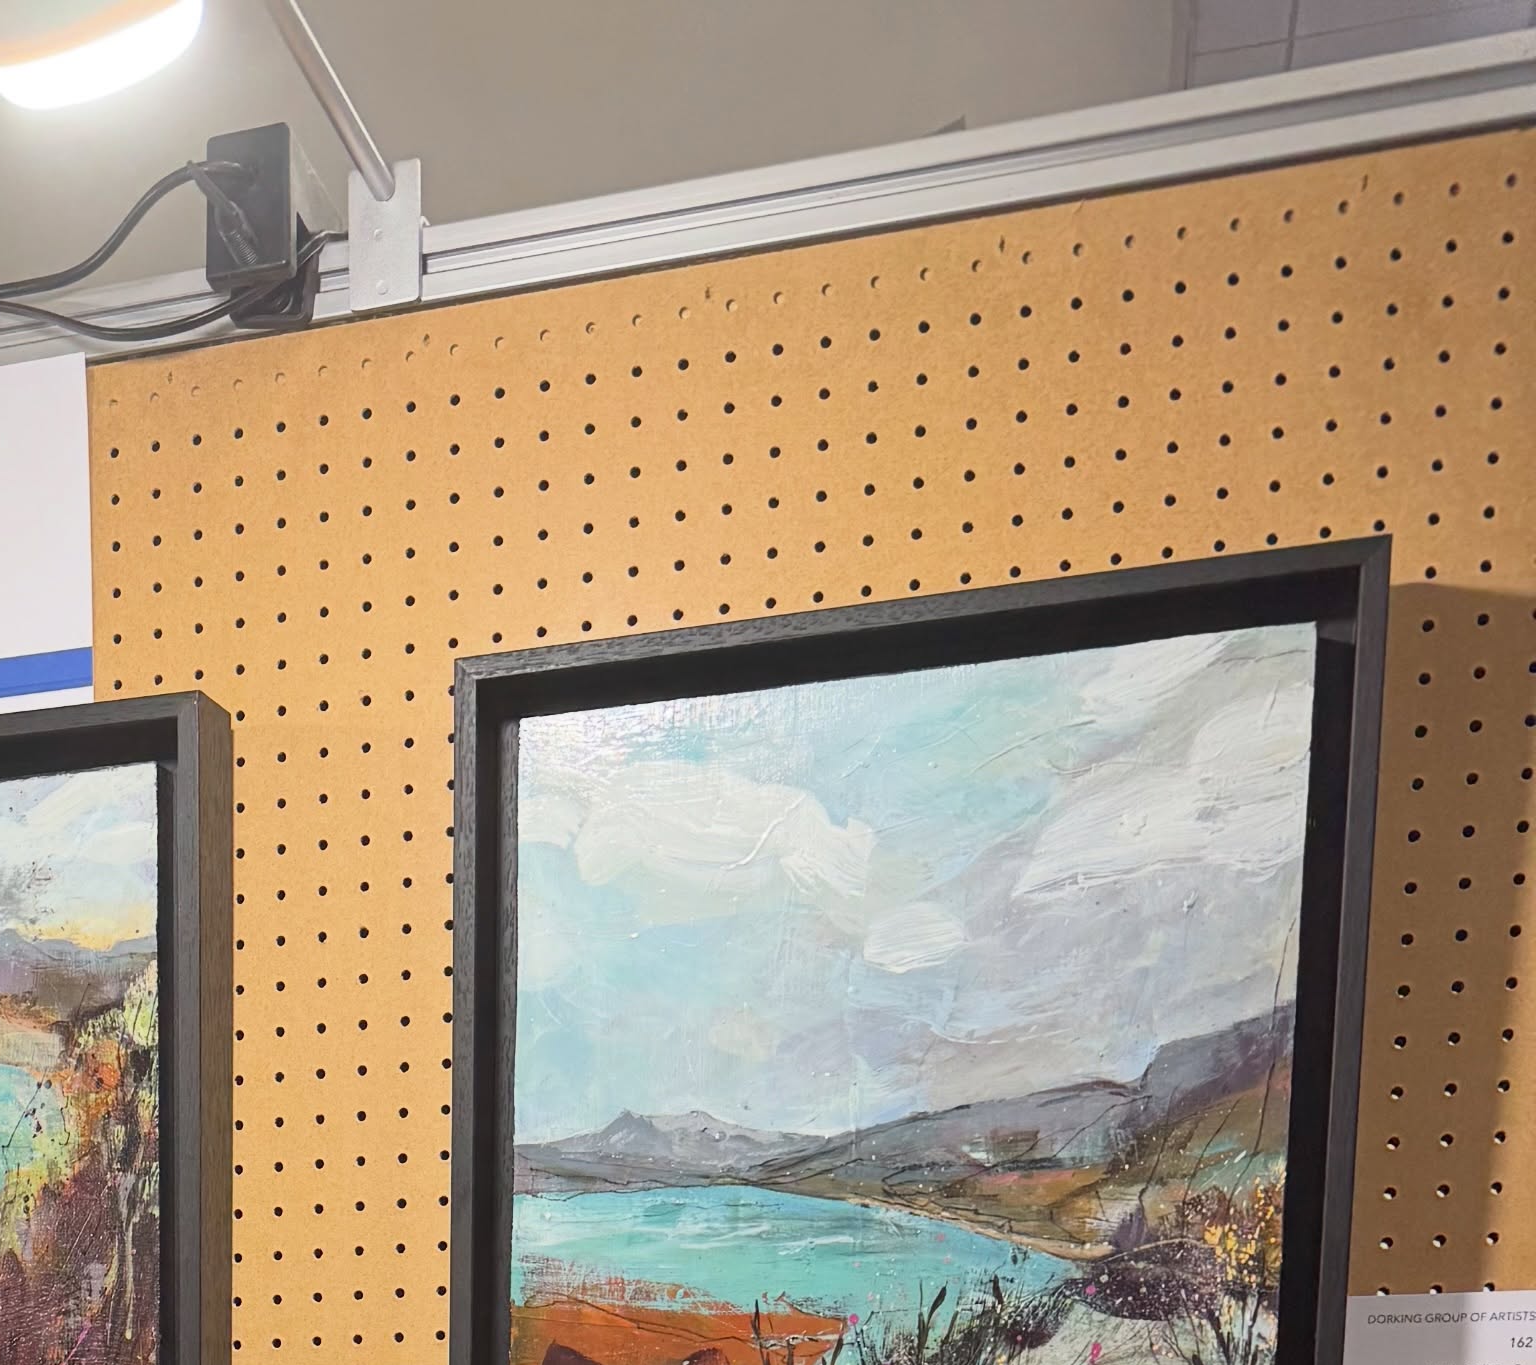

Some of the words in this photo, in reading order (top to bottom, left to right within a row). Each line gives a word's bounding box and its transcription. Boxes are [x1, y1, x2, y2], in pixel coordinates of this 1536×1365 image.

[1368, 1314, 1422, 1324] DORKING
[1425, 1313, 1467, 1323] GROUP
[1470, 1312, 1486, 1321] OF
[1489, 1311, 1536, 1321] ARTISTS
[1511, 1337, 1533, 1348] 162
